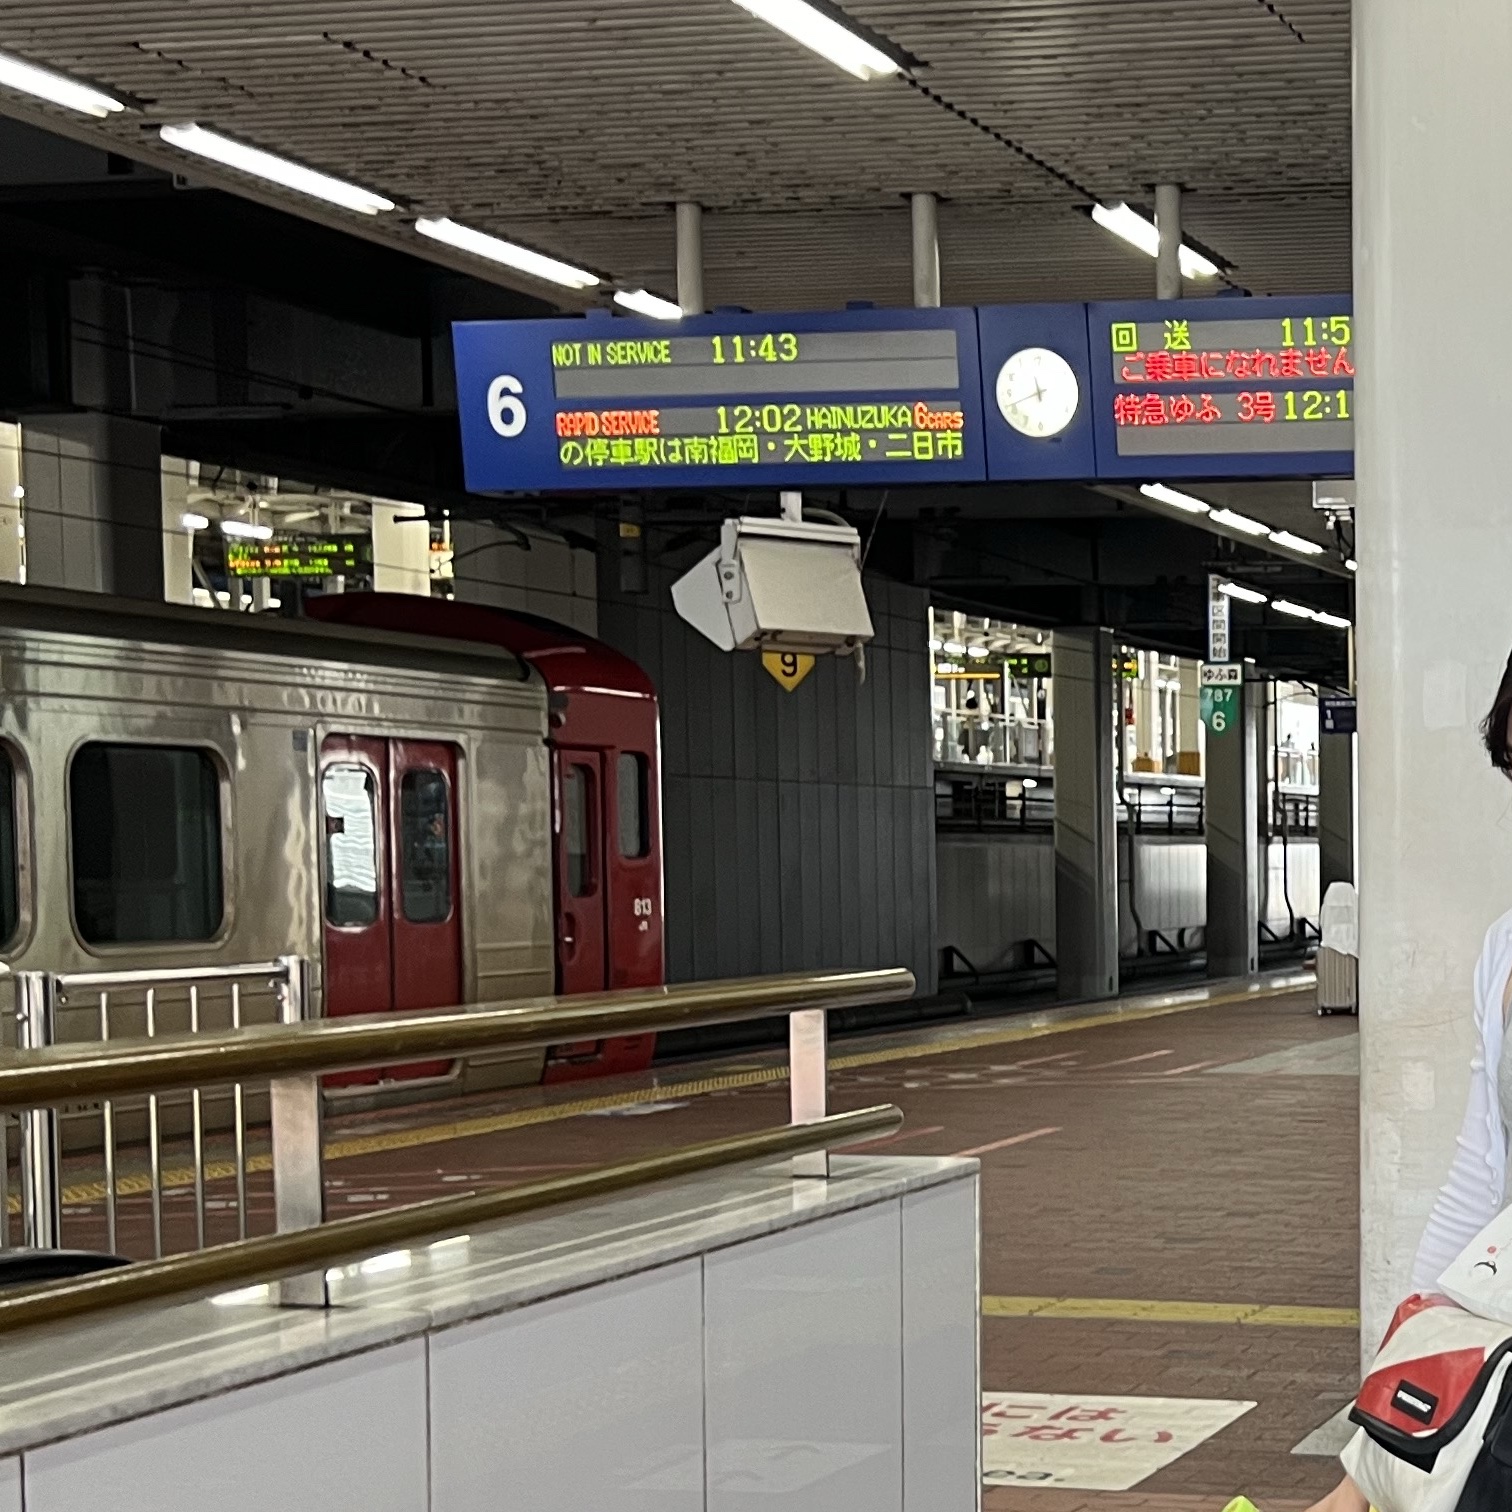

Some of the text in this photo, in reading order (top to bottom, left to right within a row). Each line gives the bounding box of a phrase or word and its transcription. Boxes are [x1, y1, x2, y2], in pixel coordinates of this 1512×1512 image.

[552, 333, 798, 366] NOT IN SERVICE 11:43
[1121, 346, 1355, 382] ご乗車になれません
[486, 374, 527, 438] 6
[556, 410, 600, 437] RAPID
[601, 409, 660, 436] SERVICE
[716, 403, 803, 434] 12:02
[806, 405, 912, 430] HAINUZUKA
[780, 652, 798, 676] 9
[1203, 687, 1233, 703] 787
[1212, 711, 1226, 731] 6
